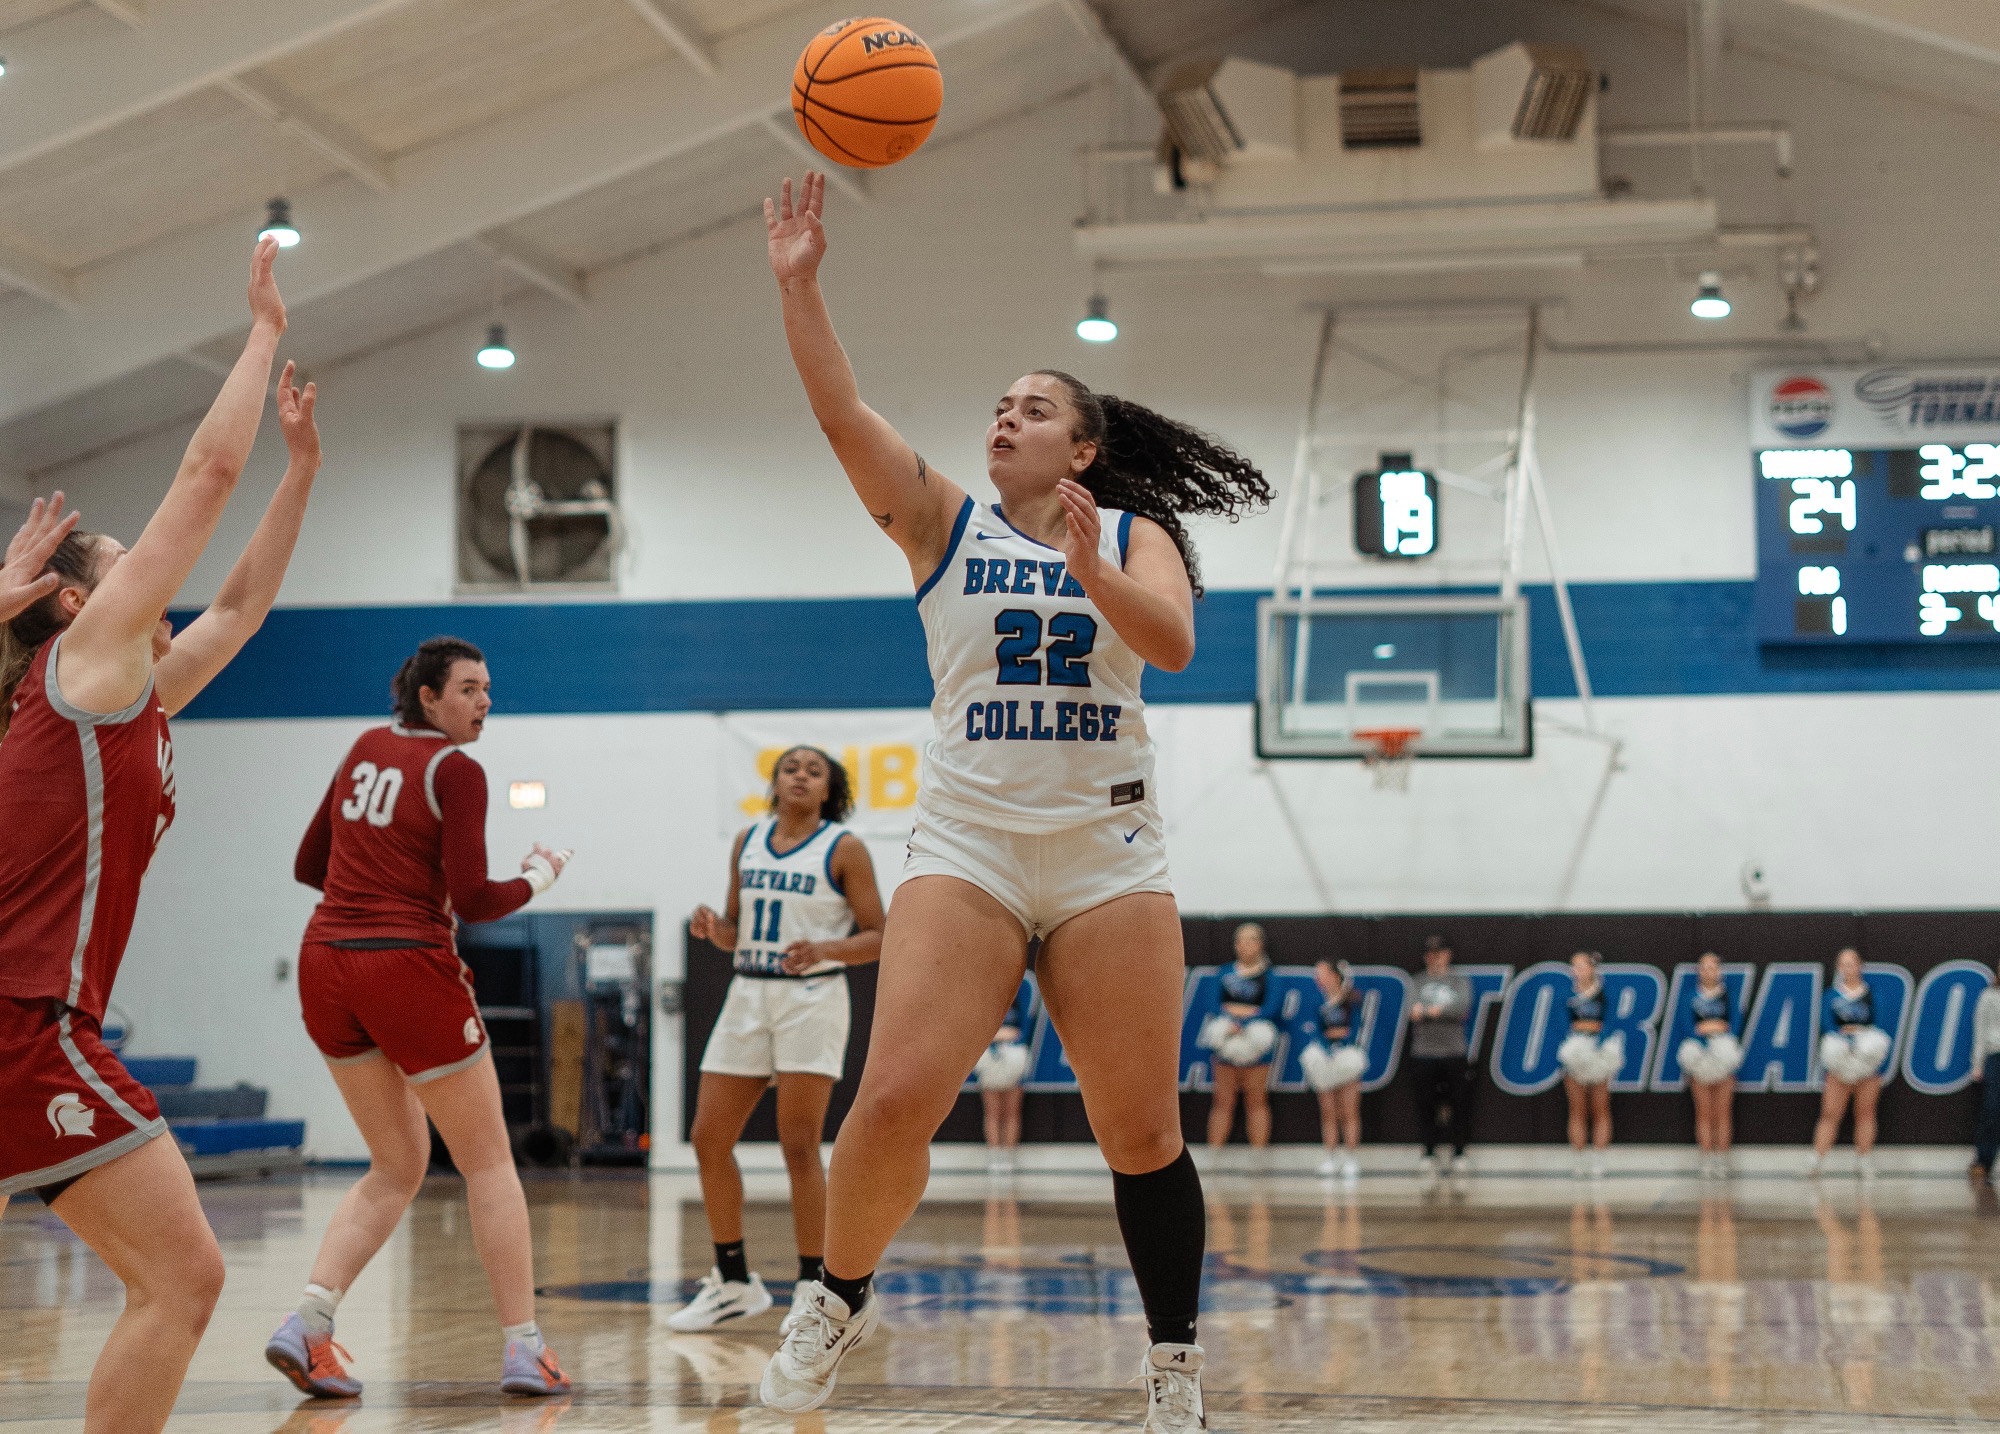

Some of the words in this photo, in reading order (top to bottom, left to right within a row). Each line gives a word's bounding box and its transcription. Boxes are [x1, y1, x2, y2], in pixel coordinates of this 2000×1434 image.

[1907, 400, 2000, 428] TORNA
[1919, 444, 2000, 500] 3:2
[1789, 478, 1857, 534] 24
[963, 558, 1091, 599] BREVA
[1831, 596, 1848, 636] 1
[994, 608, 1098, 688] 22
[965, 700, 1121, 742] COLLEGE
[341, 760, 404, 829] 30
[751, 898, 783, 942] 11
